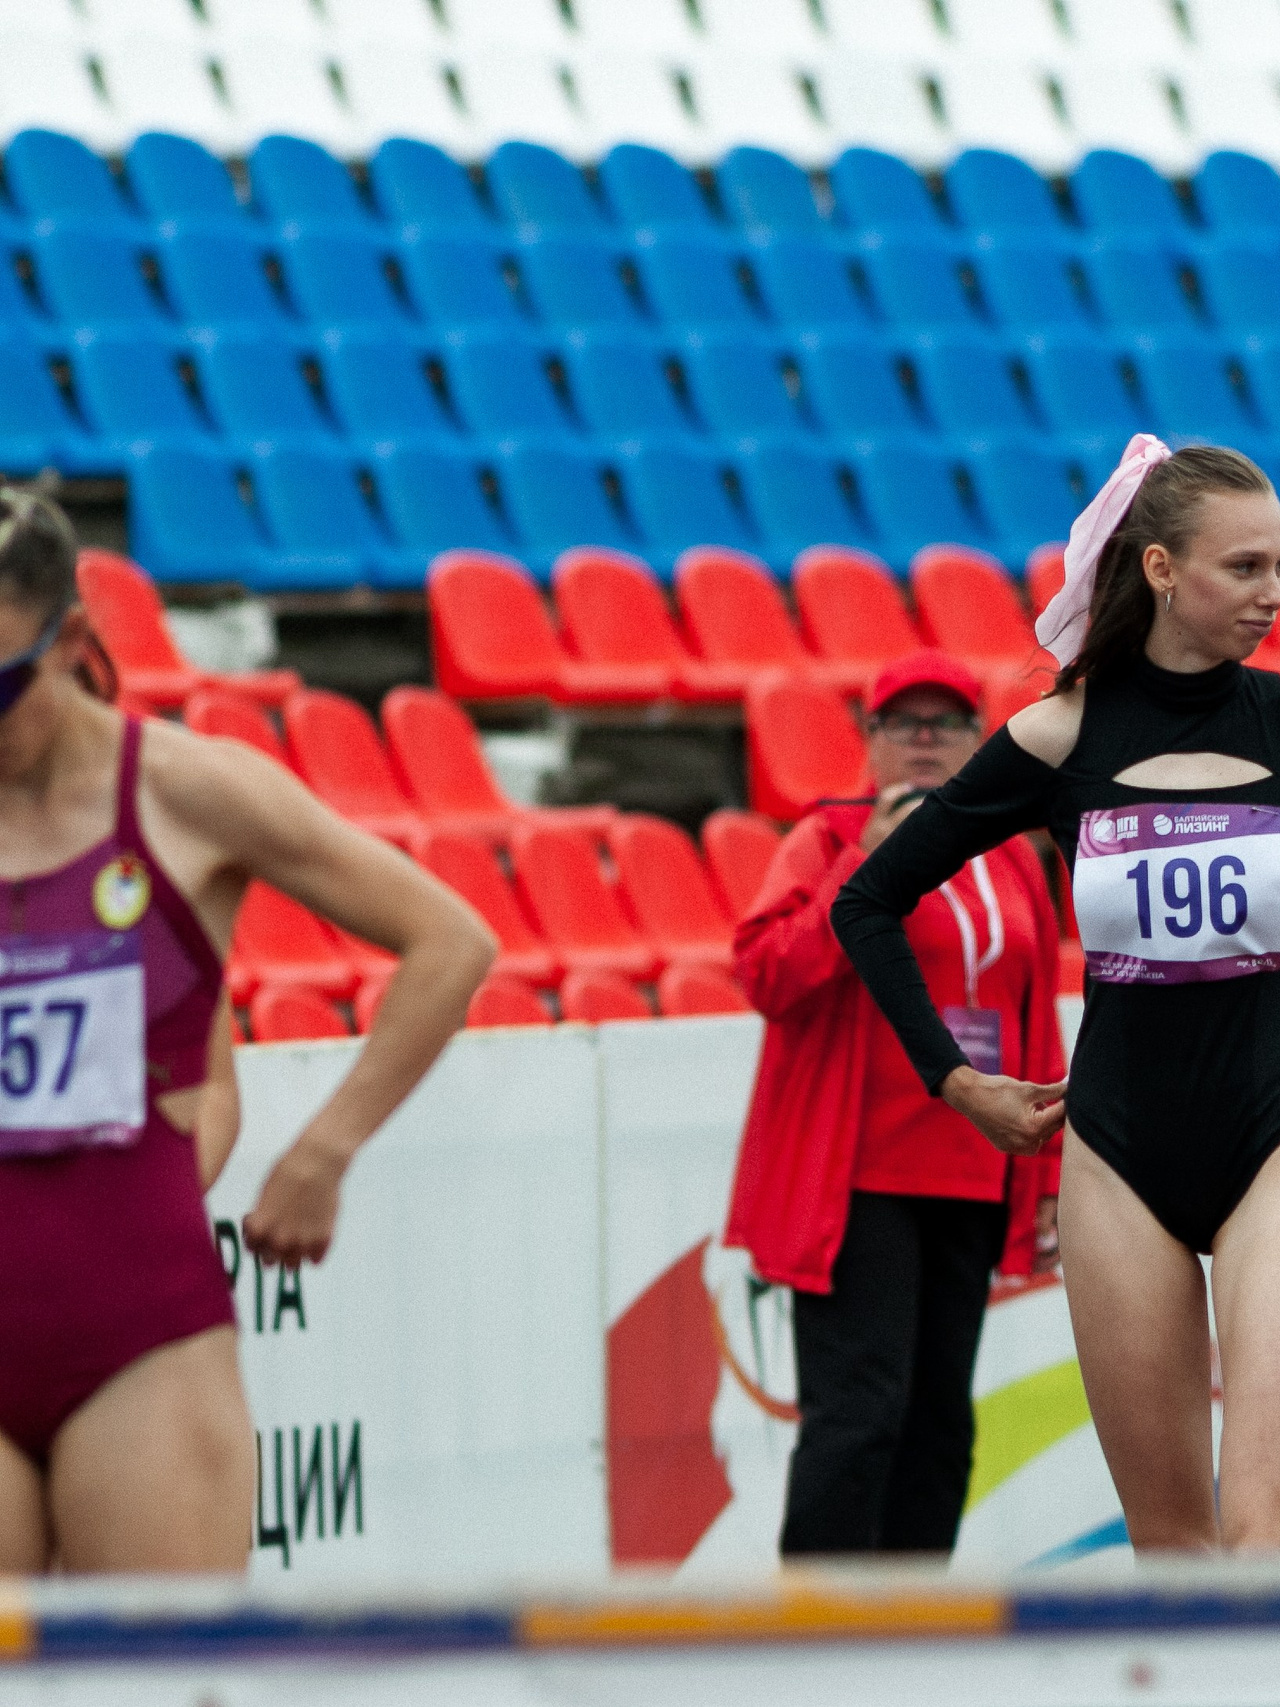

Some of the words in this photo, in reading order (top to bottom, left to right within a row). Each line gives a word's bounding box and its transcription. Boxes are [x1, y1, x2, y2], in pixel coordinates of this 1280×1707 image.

[1174, 820, 1230, 835] ЛИЗИНГ
[1126, 855, 1248, 940] 196
[0, 1001, 86, 1098] 57
